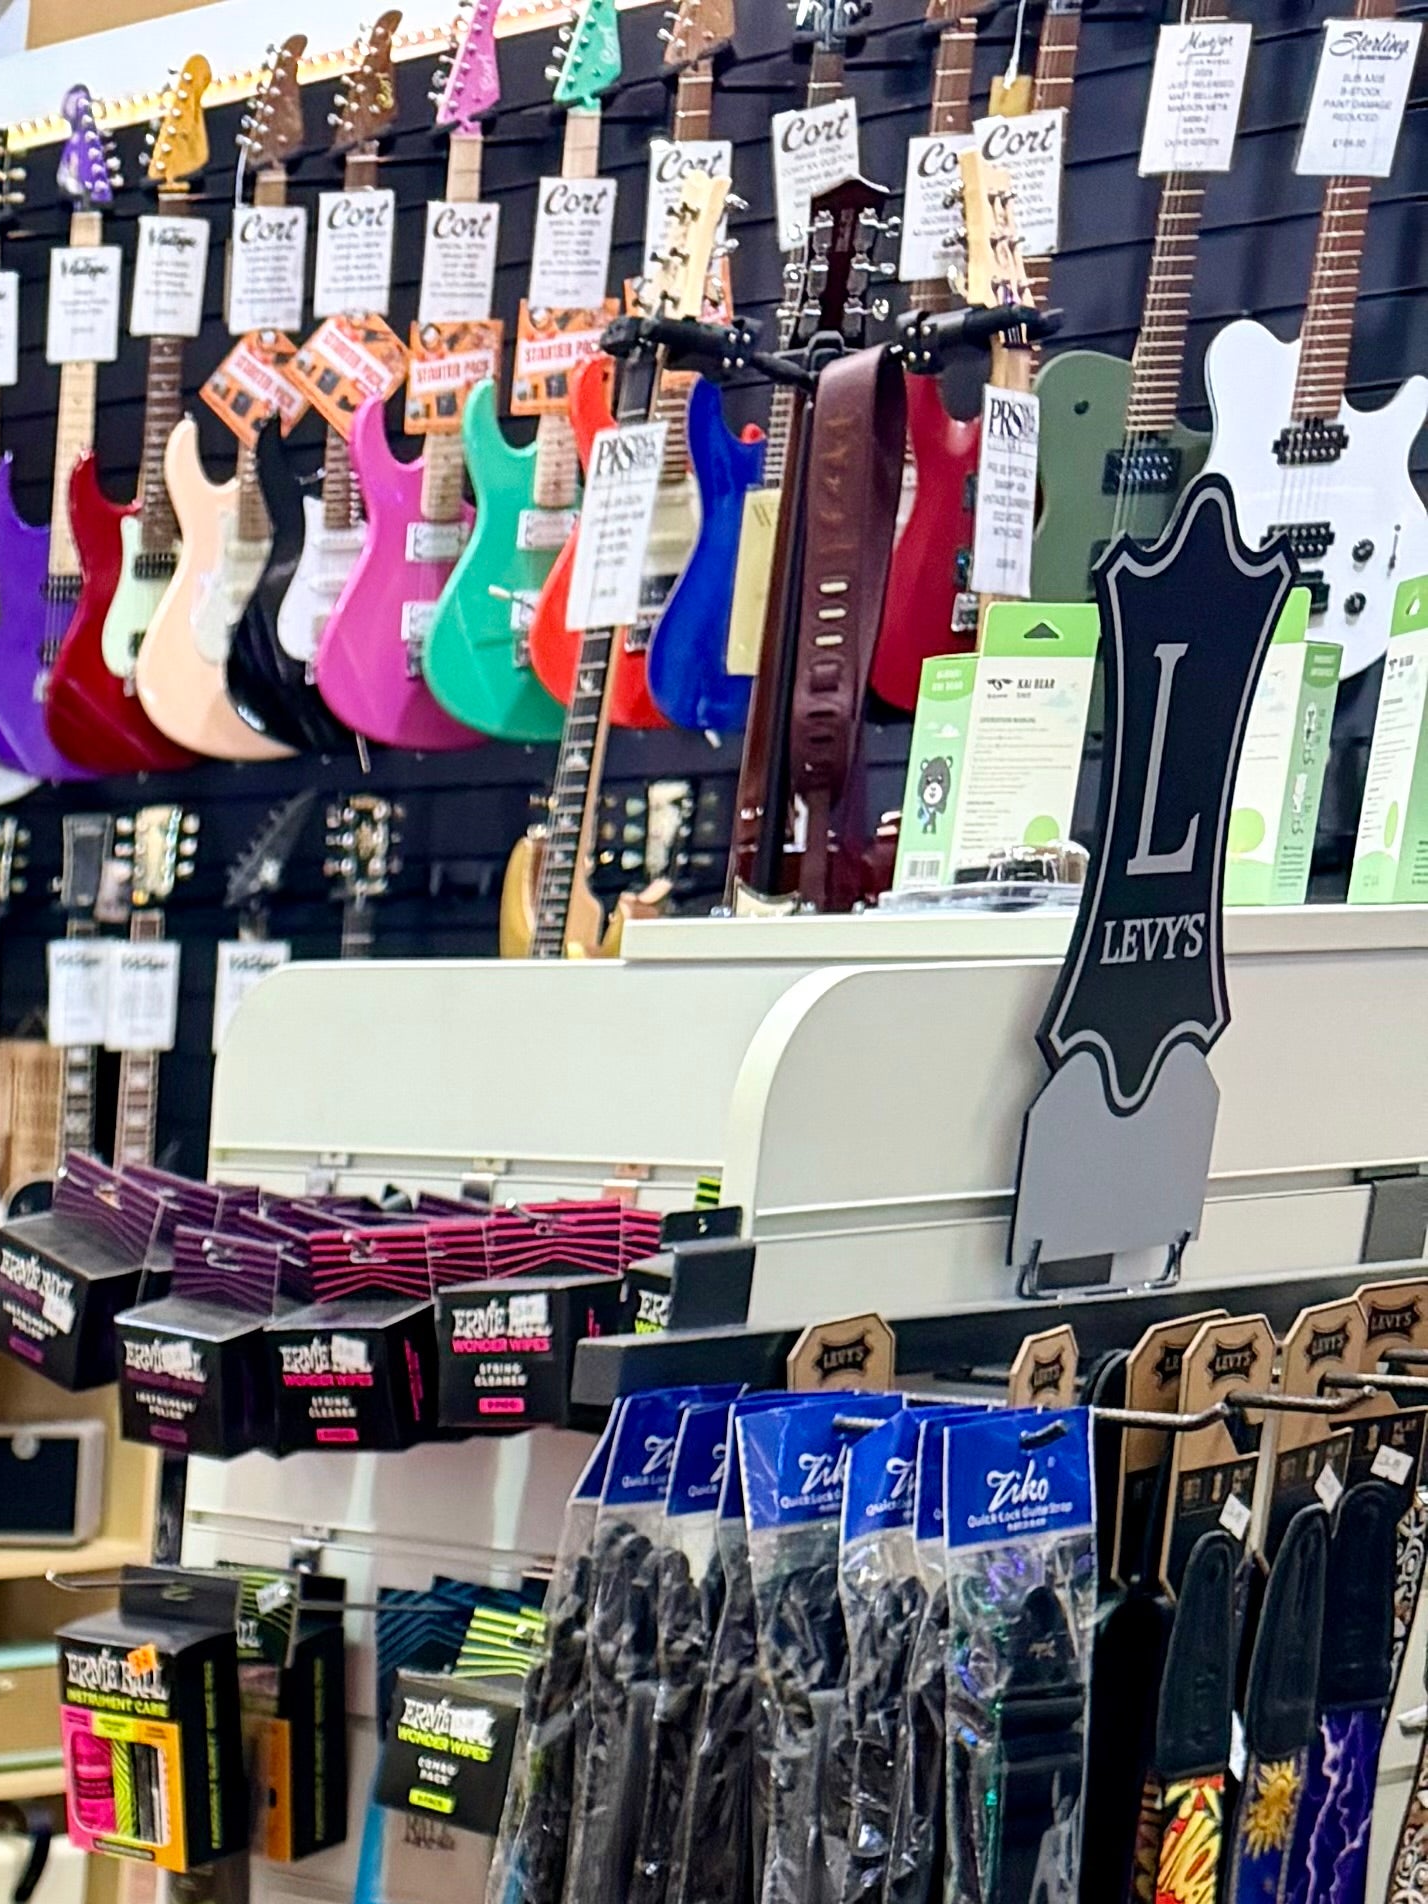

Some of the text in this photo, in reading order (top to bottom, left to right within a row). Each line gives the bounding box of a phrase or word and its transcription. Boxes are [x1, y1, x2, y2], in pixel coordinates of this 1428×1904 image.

[1328, 30, 1410, 60] Sterling
[781, 109, 849, 153] Cort
[982, 120, 1057, 161] Cort
[327, 197, 390, 230] Cort
[543, 184, 608, 216] Cort
[240, 213, 299, 244] Cort
[433, 206, 493, 240] Cort
[1033, 678, 1056, 690] BEAR
[1126, 642, 1201, 877] L
[1099, 911, 1207, 967] LEVY'S
[452, 1299, 507, 1338] ERNIE
[452, 1337, 552, 1353] WONDER WIPES
[986, 1459, 1049, 1513] Ziko
[967, 1511, 998, 1529] Quick
[64, 1646, 121, 1691] ERNIE
[66, 1686, 170, 1718] INSTRUMENT CARE
[397, 1723, 493, 1763] WONDER WIPES
